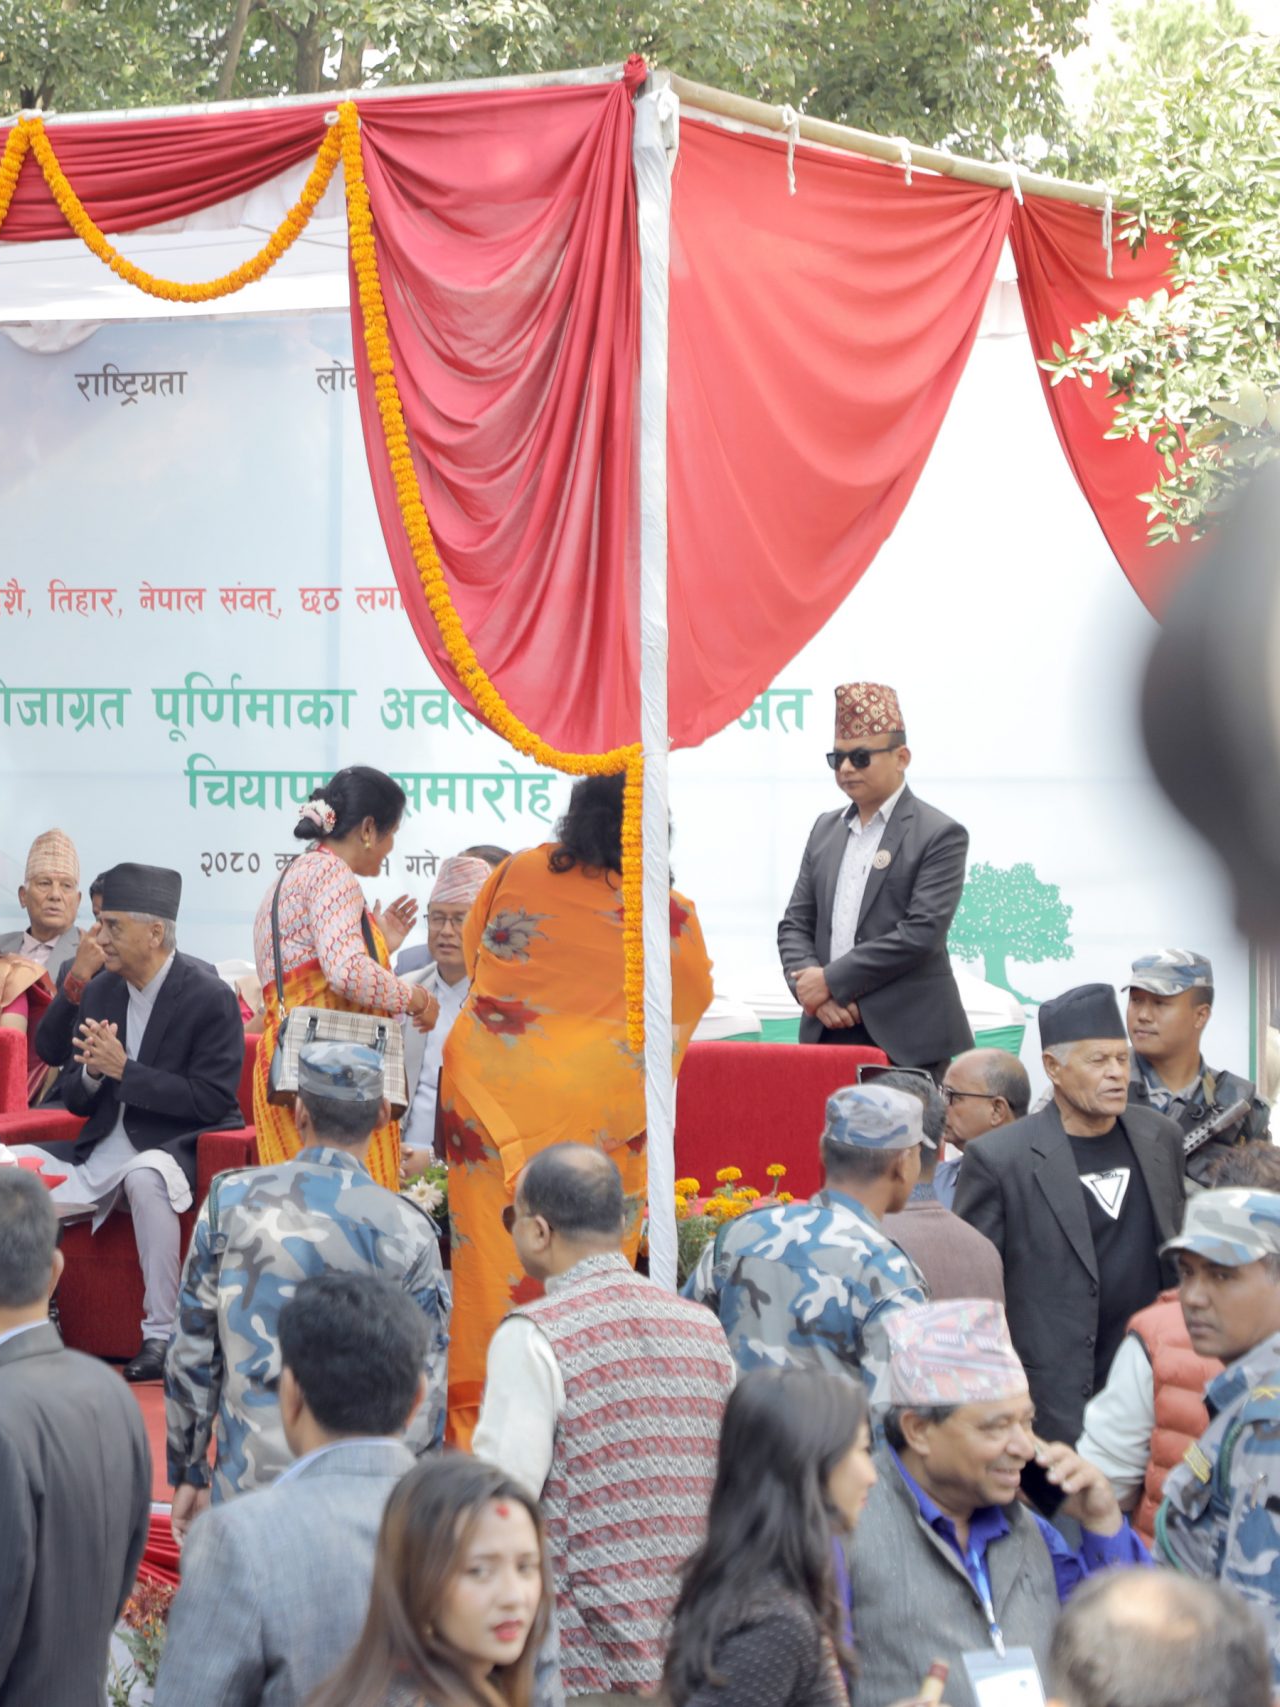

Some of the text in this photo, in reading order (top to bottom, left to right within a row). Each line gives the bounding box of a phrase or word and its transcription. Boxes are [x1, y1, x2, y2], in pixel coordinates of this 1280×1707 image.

[74, 363, 188, 406] राष्ट्रियता
[48, 578, 122, 618] तिहार,
[139, 581, 207, 614] नेपाल
[298, 587, 342, 614] छठ
[151, 671, 358, 742] पूर्णिमाका
[183, 753, 337, 811] चियाप
[200, 851, 261, 877] २०८०
[404, 849, 440, 878] गते
